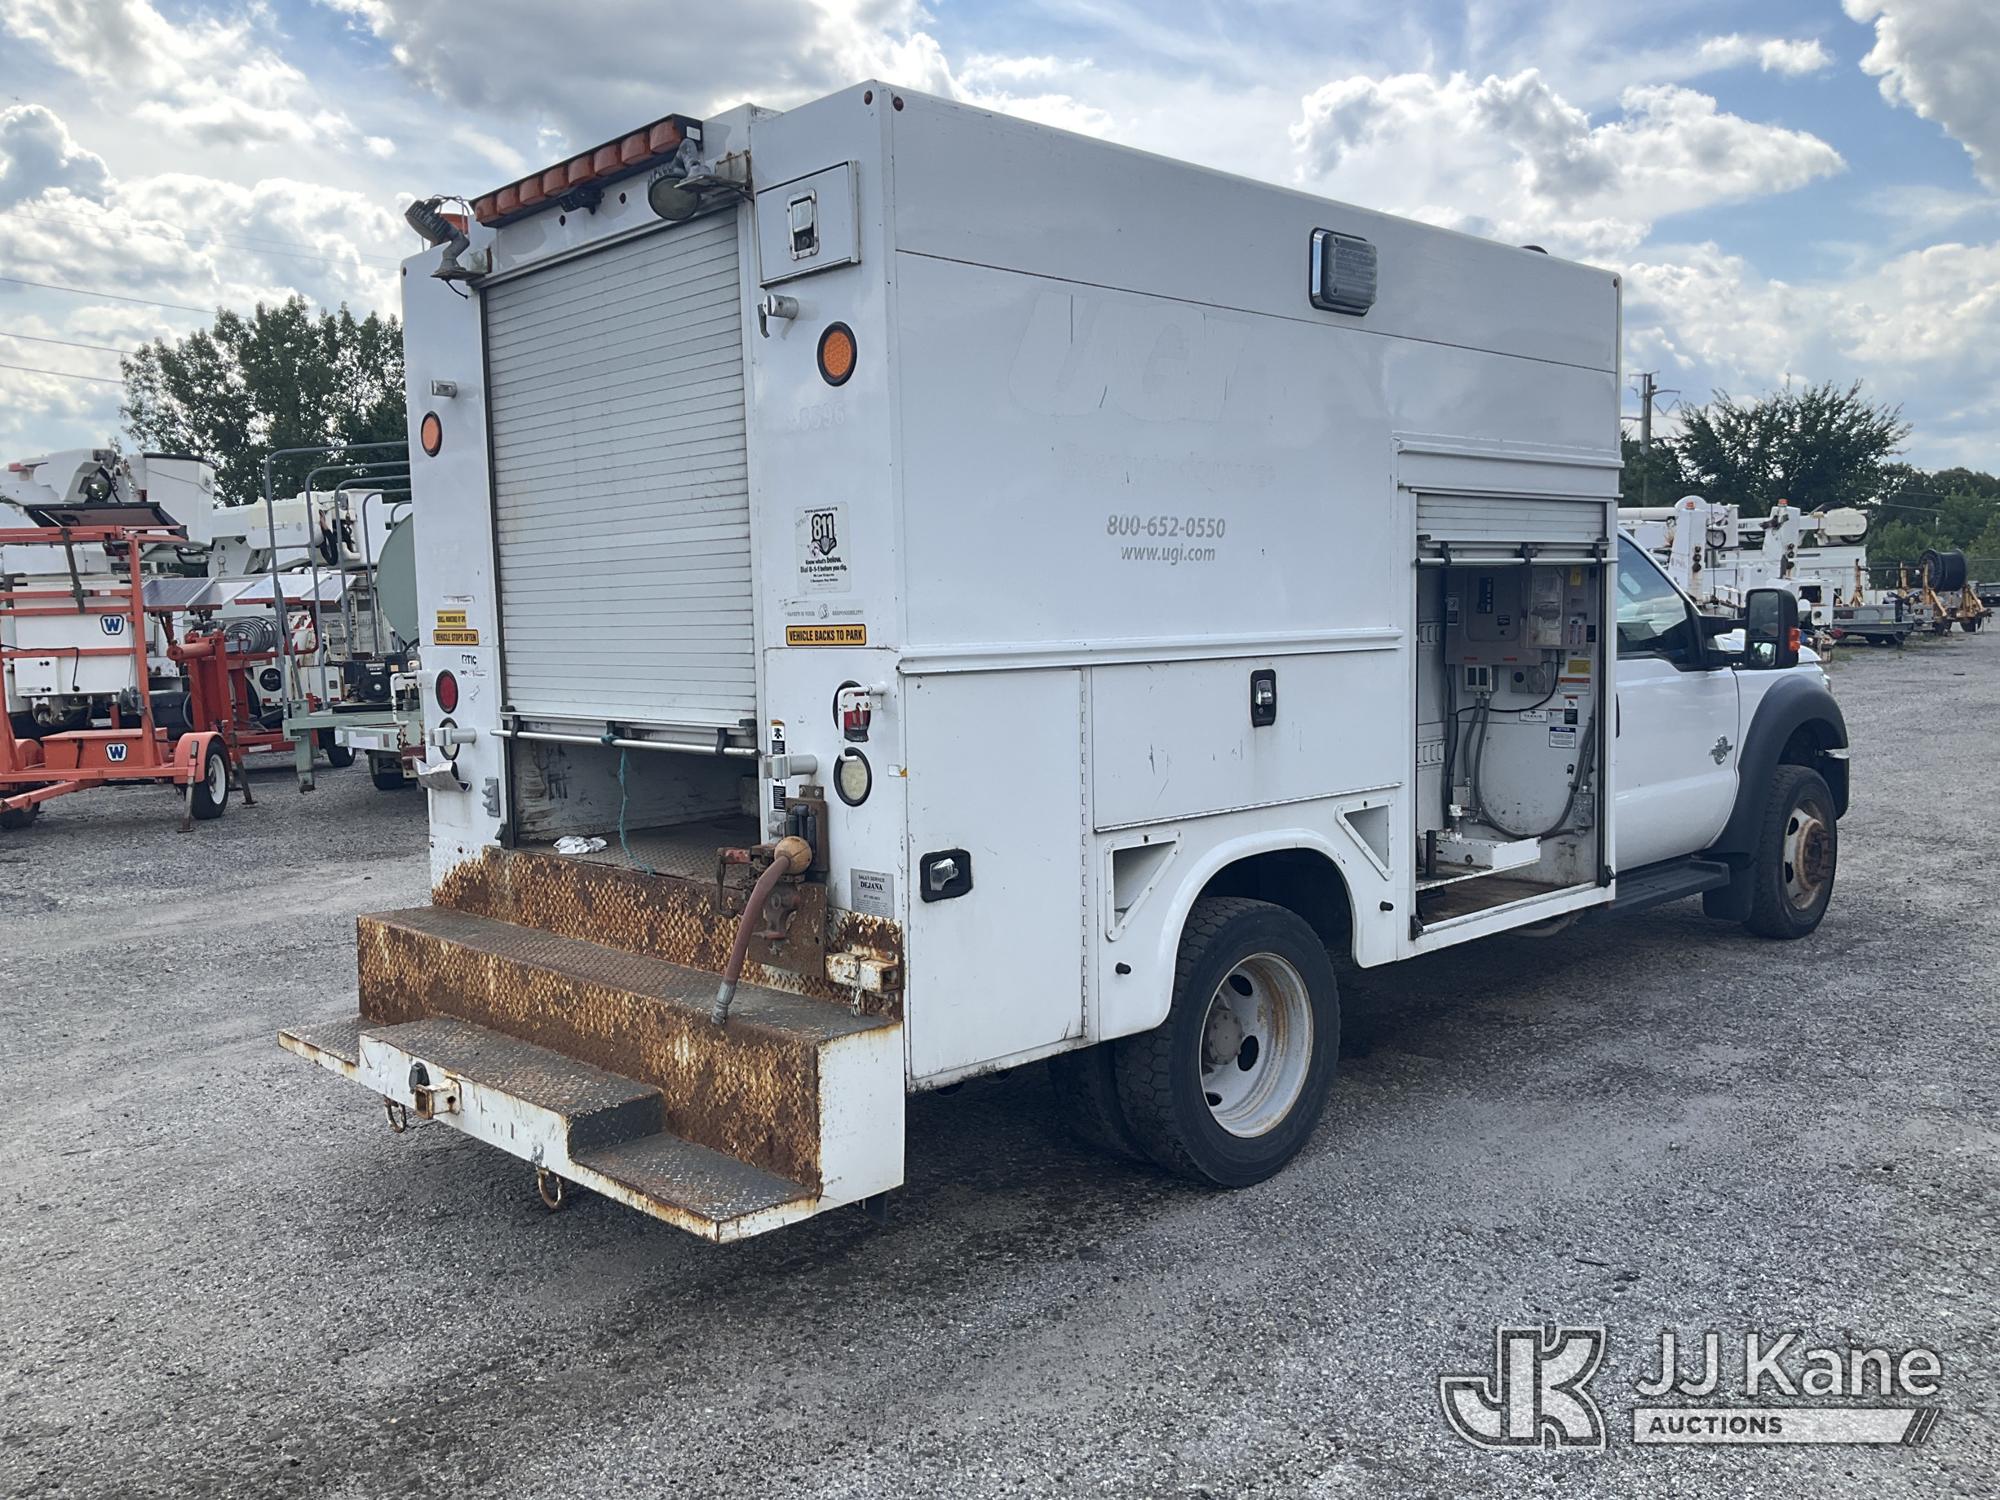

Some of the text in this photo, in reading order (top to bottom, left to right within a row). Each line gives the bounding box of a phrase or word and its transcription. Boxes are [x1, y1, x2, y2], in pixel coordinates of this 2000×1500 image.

[811, 514, 835, 541] 811
[1107, 515, 1226, 538] 800-652-0550
[1121, 543, 1216, 566] www.ugi.com
[789, 629, 863, 641] VEHICLE BACKS TO PARK
[861, 881, 883, 890] DEJANA
